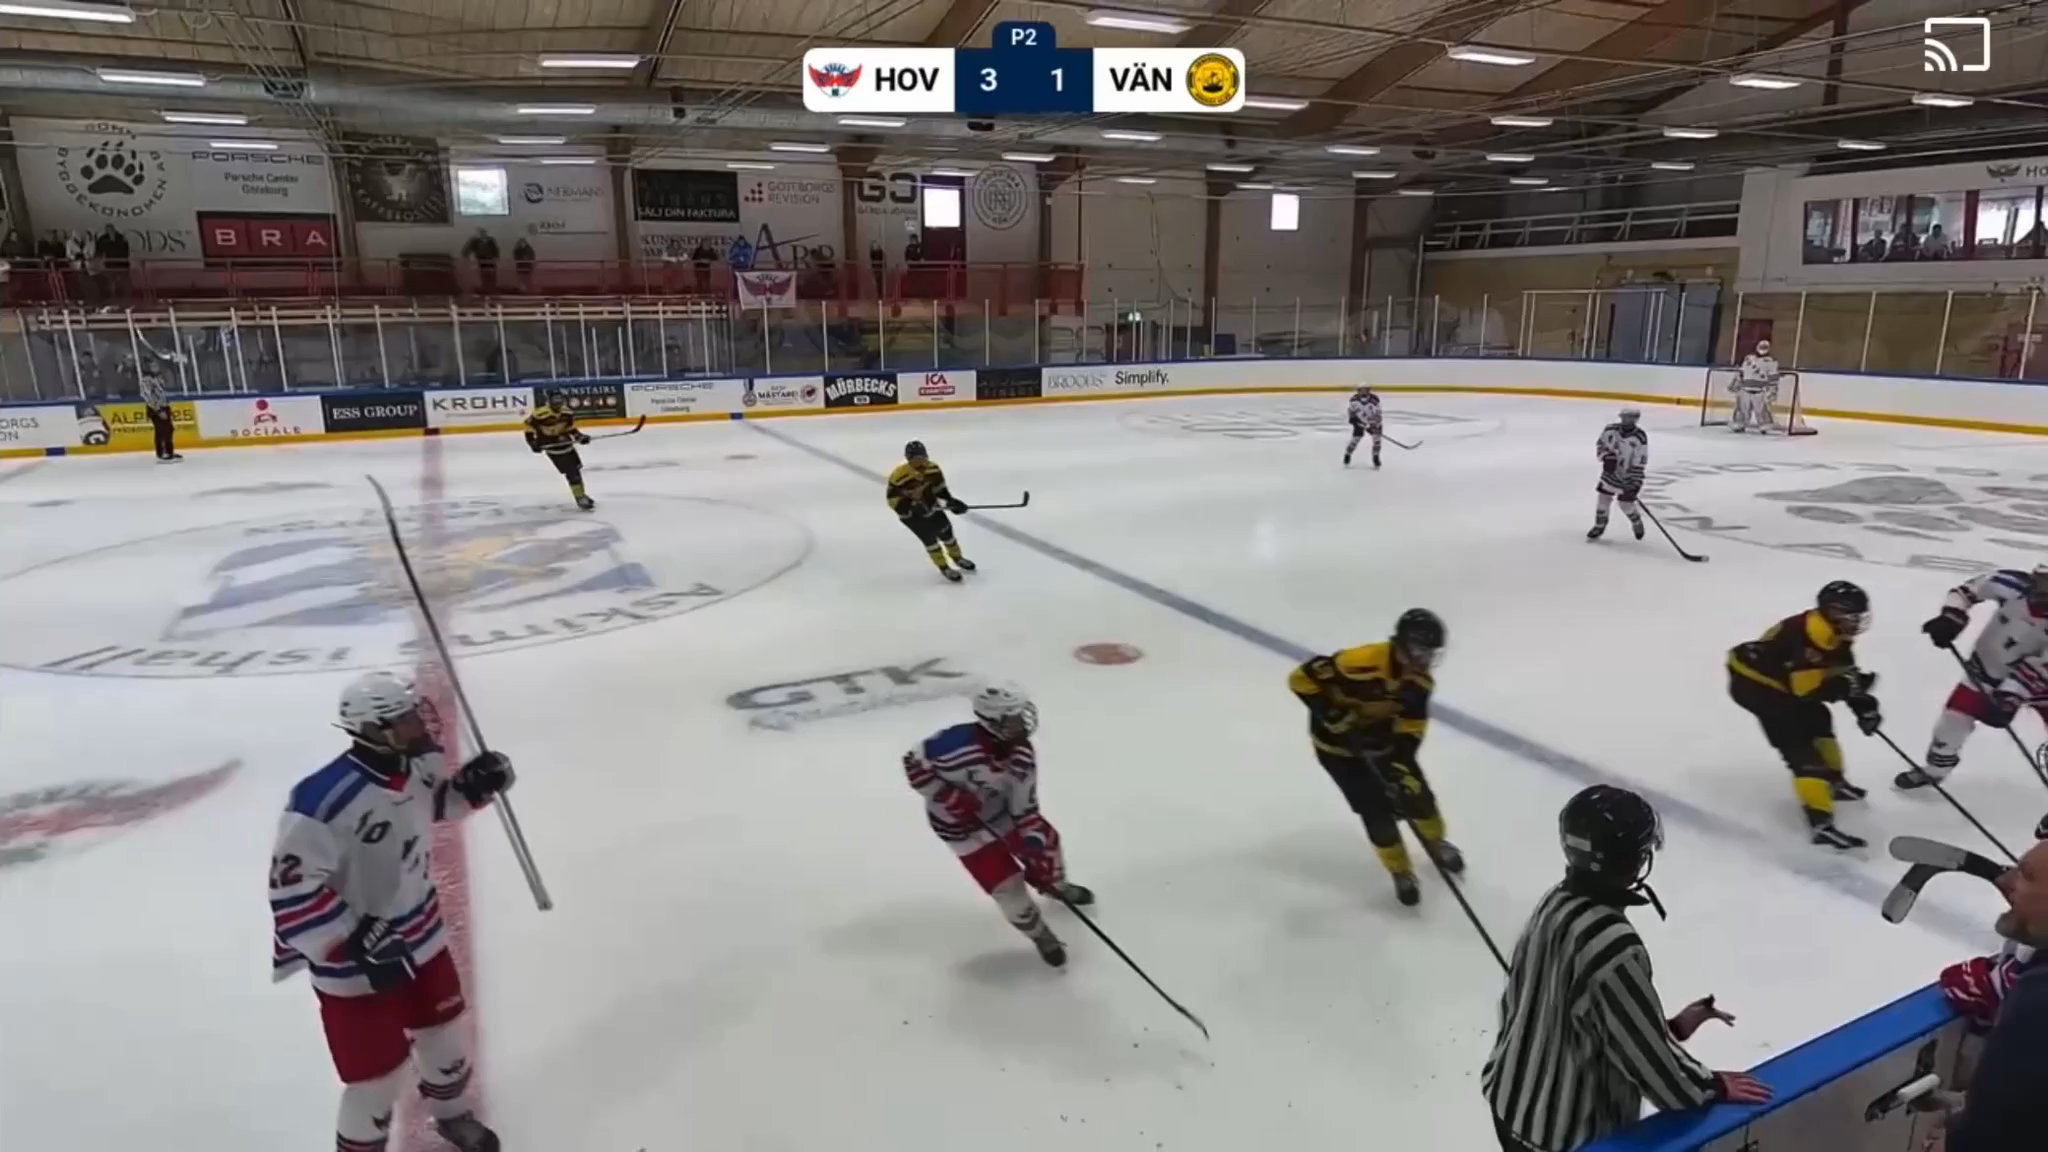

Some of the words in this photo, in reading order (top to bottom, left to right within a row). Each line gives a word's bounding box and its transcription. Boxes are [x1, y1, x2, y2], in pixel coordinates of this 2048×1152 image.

[191, 151, 324, 165] PORSCHE
[664, 208, 685, 218] DIN
[214, 228, 328, 247] BRA
[925, 373, 948, 386] ICA
[1114, 370, 1170, 388] Simplify.
[431, 393, 528, 412] KROHN
[332, 406, 361, 421] ESS
[363, 404, 418, 419] GROUP
[230, 425, 302, 437] SOCIALE
